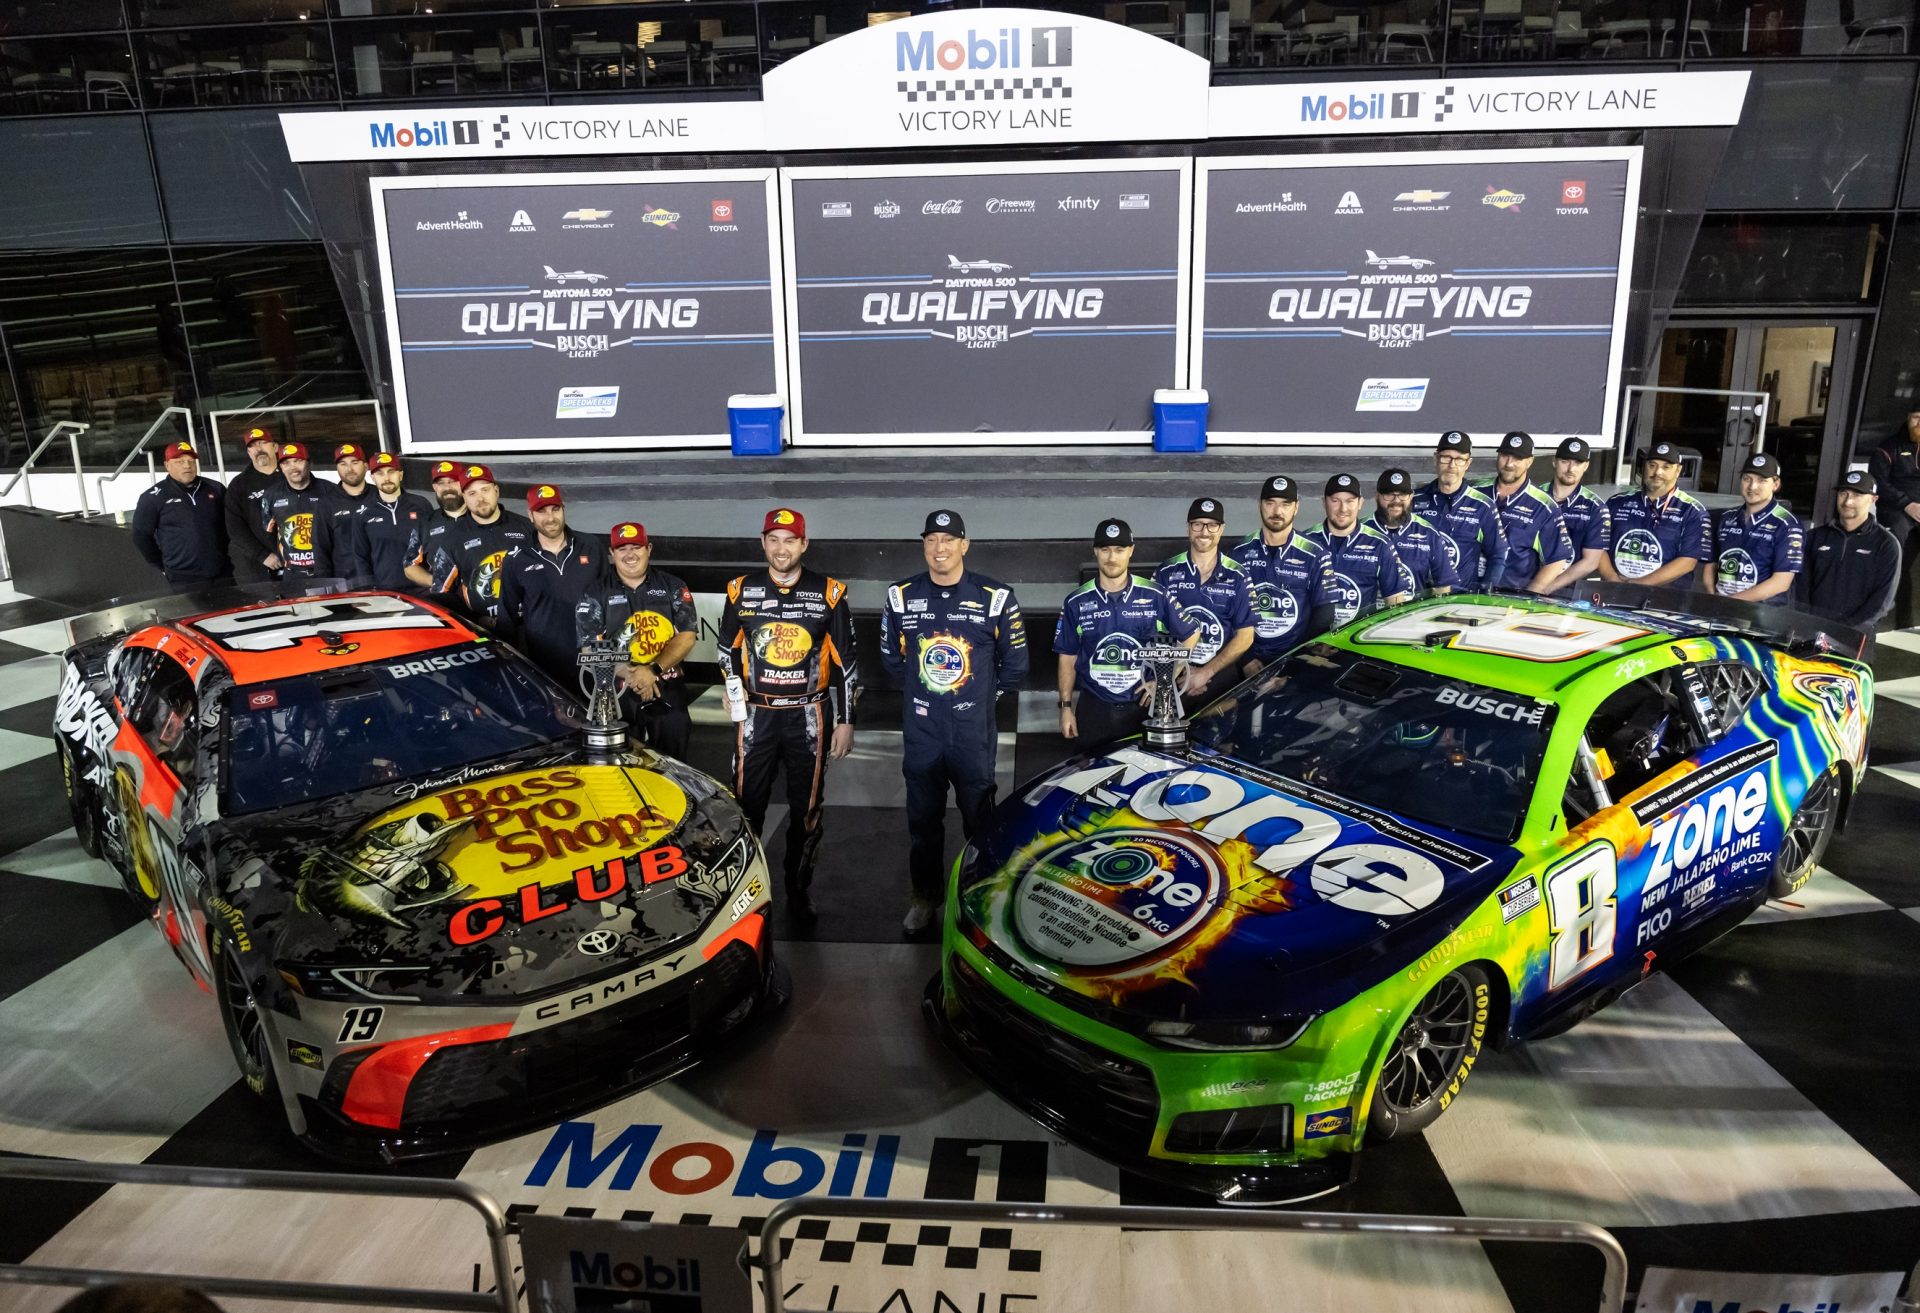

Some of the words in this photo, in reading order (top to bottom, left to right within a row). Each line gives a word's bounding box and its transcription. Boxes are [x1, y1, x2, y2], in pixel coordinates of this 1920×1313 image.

[896, 28, 1020, 72] Mobil
[1301, 93, 1384, 122] Mobil
[1468, 90, 1582, 114] VICTORY
[1587, 88, 1658, 111] LANE
[899, 110, 1001, 131] VICTORY
[1010, 108, 1072, 129] LANE
[370, 121, 448, 148] Mobil
[522, 120, 621, 142] VICTORY
[629, 118, 690, 139] LANE
[1000, 199, 1035, 208] Freeway
[1057, 195, 1100, 211] xfinity
[1235, 200, 1307, 214] AdventHealth
[1483, 194, 1525, 205] SUNOCO
[643, 212, 680, 223] SUNOCO
[874, 205, 900, 215] BUSCH
[1334, 207, 1364, 215] AXALTA
[1556, 207, 1589, 215] TOYOTA
[416, 219, 483, 231] AdventHealth
[509, 224, 536, 232] AXALTA
[945, 278, 991, 287] DAYTONA
[994, 277, 1016, 287] 500
[1361, 274, 1411, 285] DAYTONA
[1413, 274, 1438, 284] 500
[543, 289, 591, 298] DAYTONA
[592, 288, 613, 298] 500
[862, 288, 1104, 324] QUALIFYING
[1268, 286, 1532, 322] QUALIFYING
[462, 298, 699, 335] QUALIFYING
[956, 325, 1009, 342] BUSCH
[1367, 323, 1425, 342] BUSCH
[557, 335, 609, 351] BUSCH
[967, 341, 997, 349] LIGHT
[1379, 340, 1410, 348] LIGHT
[569, 350, 598, 358] LIGHT
[562, 399, 613, 407] SPEEDWEEKS
[1364, 391, 1420, 399] SPEEDWEEKS
[1621, 537, 1659, 554] zone
[796, 591, 823, 599] TOYOTA
[634, 614, 659, 630] Bass
[1093, 610, 1111, 619] FICO
[636, 628, 656, 641] Pro
[773, 623, 799, 637] Bass
[774, 638, 793, 649] Pro
[388, 647, 496, 679] BRISCOE
[580, 654, 629, 663] QUALIFYING
[773, 646, 806, 662] Shops
[928, 650, 960, 664] zone
[764, 669, 805, 679] TRACKER
[1435, 687, 1537, 724] BUSCH
[394, 773, 464, 800] Johnny
[458, 761, 524, 787] Morris
[436, 769, 586, 822] Bass
[1658, 796, 1669, 806] This
[1668, 787, 1683, 802] product
[474, 799, 581, 843] Pro
[1236, 765, 1271, 782] contains
[1271, 779, 1308, 797] nicotine.
[1311, 793, 1349, 811] Nicotine
[1350, 804, 1360, 813] is
[1360, 810, 1374, 820] an
[1374, 815, 1422, 842] addictive
[1421, 836, 1472, 863] chemical.
[497, 805, 674, 874] Shops
[1641, 771, 1767, 894] zone
[1144, 837, 1180, 851] NICOTINE
[1177, 846, 1201, 870] POUCHES
[1730, 856, 1748, 873] Bank
[1748, 851, 1773, 865] OZK
[1042, 865, 1084, 887] JALAPEÑO
[1081, 882, 1104, 896] LIME
[1071, 840, 1202, 907] zone
[1641, 882, 1669, 912] NEW
[1671, 846, 1729, 895] JALAPEÑO
[1730, 831, 1761, 858] LIME
[448, 845, 689, 947] CLUB
[1511, 880, 1532, 898] NASCAR
[1043, 884, 1083, 908] WARNING:
[1083, 904, 1099, 919] This
[208, 896, 252, 953] GOODYEAR
[1027, 892, 1059, 912] contains
[1059, 905, 1090, 928] nicotine.
[1092, 925, 1128, 948] Nicotine
[1133, 904, 1153, 920] 6
[1151, 918, 1170, 933] MG
[1547, 840, 1616, 990] 8
[1038, 911, 1046, 920] is
[1046, 914, 1057, 925] an
[1056, 918, 1094, 945] addictive
[1636, 907, 1672, 946] FICO
[1038, 924, 1076, 949] chemical
[1408, 924, 1493, 983] GOODYEAR
[536, 954, 688, 1021] CAMRY
[336, 1006, 386, 1045] 19
[291, 1048, 322, 1063] SUNOCO
[1304, 1083, 1363, 1102] PACK-RAT
[1306, 1116, 1351, 1132] SUNOCO
[523, 1121, 900, 1199] Mobil
[569, 1250, 699, 1292] Mobil
